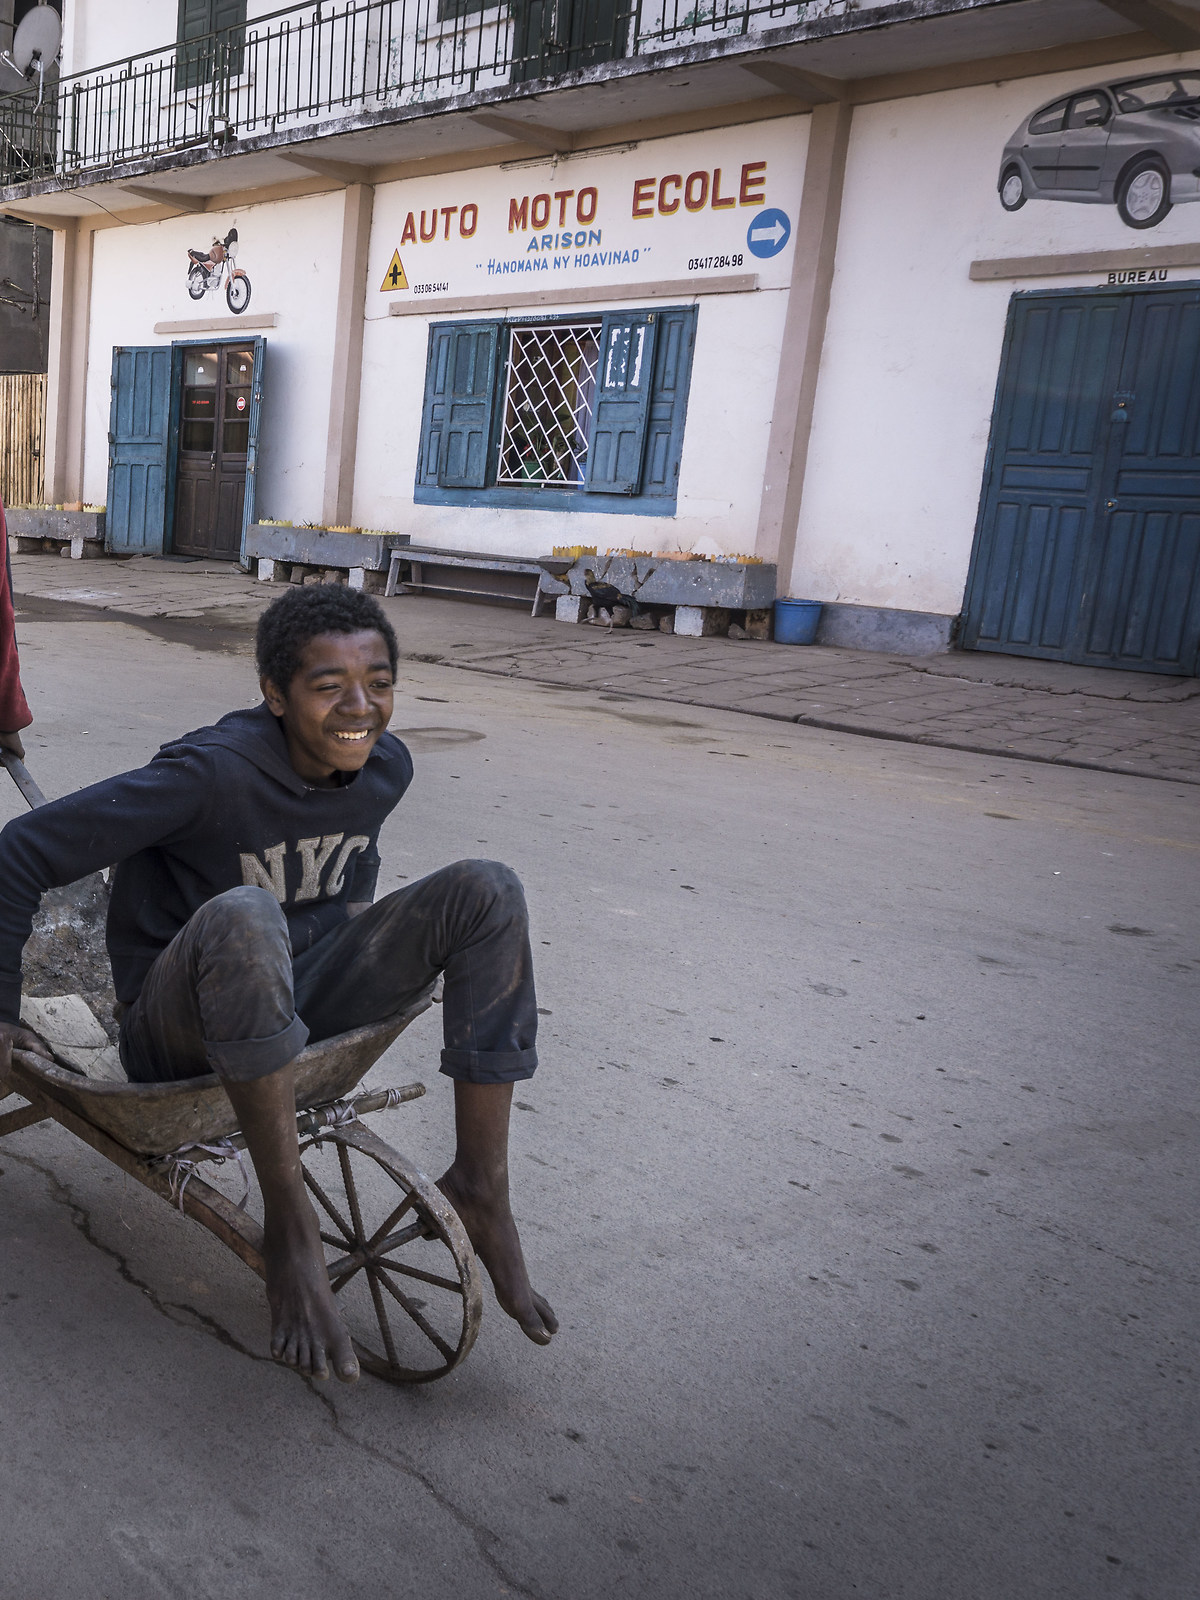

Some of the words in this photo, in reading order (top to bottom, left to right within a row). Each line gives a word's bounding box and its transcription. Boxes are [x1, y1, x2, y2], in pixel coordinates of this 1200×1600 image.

[400, 203, 478, 246] AUTO
[508, 186, 598, 233] MOTO
[631, 161, 767, 219] ECOLE
[526, 229, 601, 253] ARISON
[554, 255, 570, 269] NY
[1108, 269, 1168, 284] BUREAU
[239, 831, 370, 902] NYC
